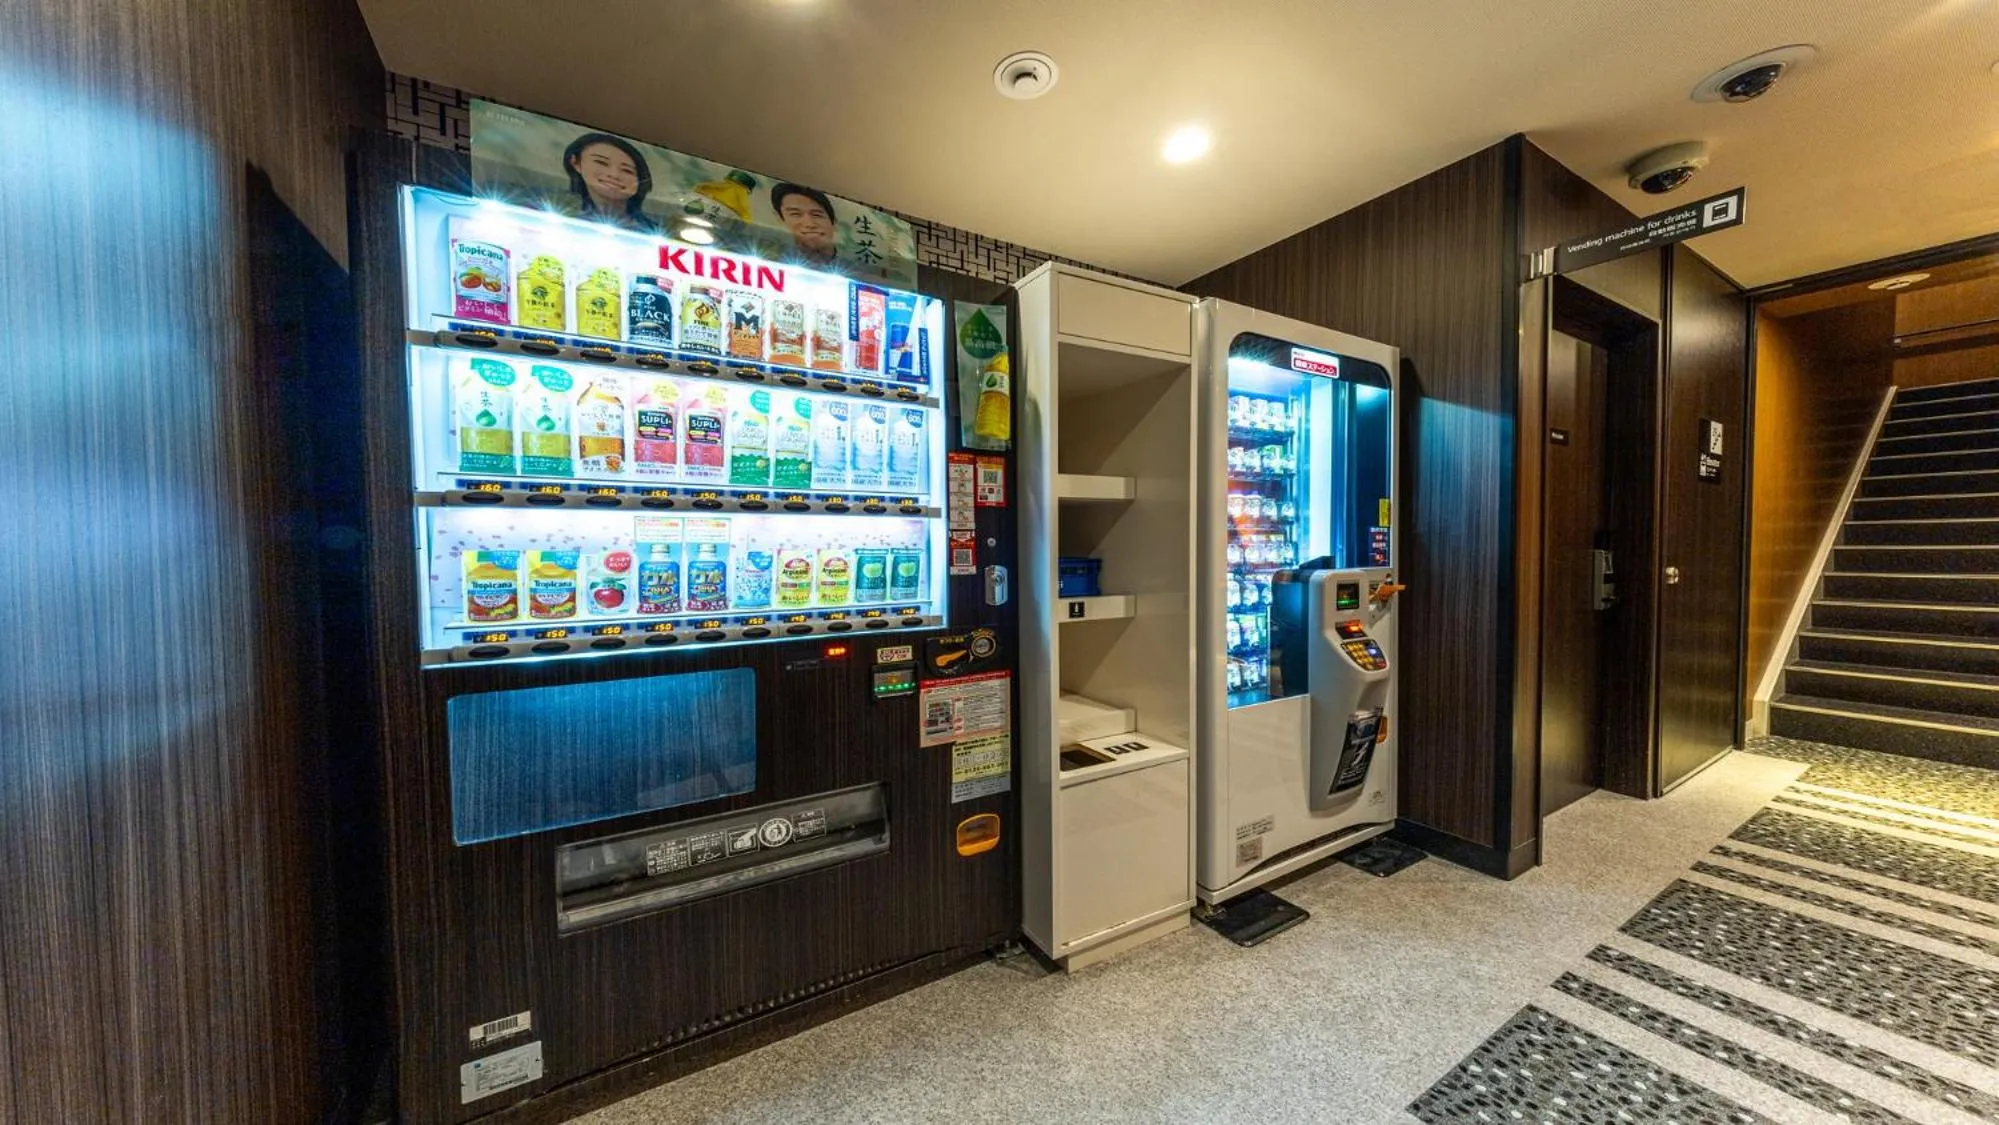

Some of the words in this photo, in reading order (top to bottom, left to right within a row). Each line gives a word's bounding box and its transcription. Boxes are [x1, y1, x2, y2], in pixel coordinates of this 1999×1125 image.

[1567, 238, 1603, 253] Vending
[1605, 225, 1645, 243] machine
[1647, 220, 1661, 231] for
[1664, 209, 1697, 225] drinks
[854, 215, 883, 265] 生茶
[458, 243, 504, 261] Tropicana
[658, 244, 785, 293] KIRIN
[631, 308, 670, 322] BLACK
[480, 484, 501, 492] 160
[541, 486, 561, 494] 160
[471, 580, 513, 589] Tropicana
[533, 579, 573, 588] Tropicana
[655, 622, 672, 631] 150
[703, 620, 720, 628] 150
[546, 630, 566, 638] 150
[602, 626, 621, 634] 150
[486, 633, 507, 642] 150
